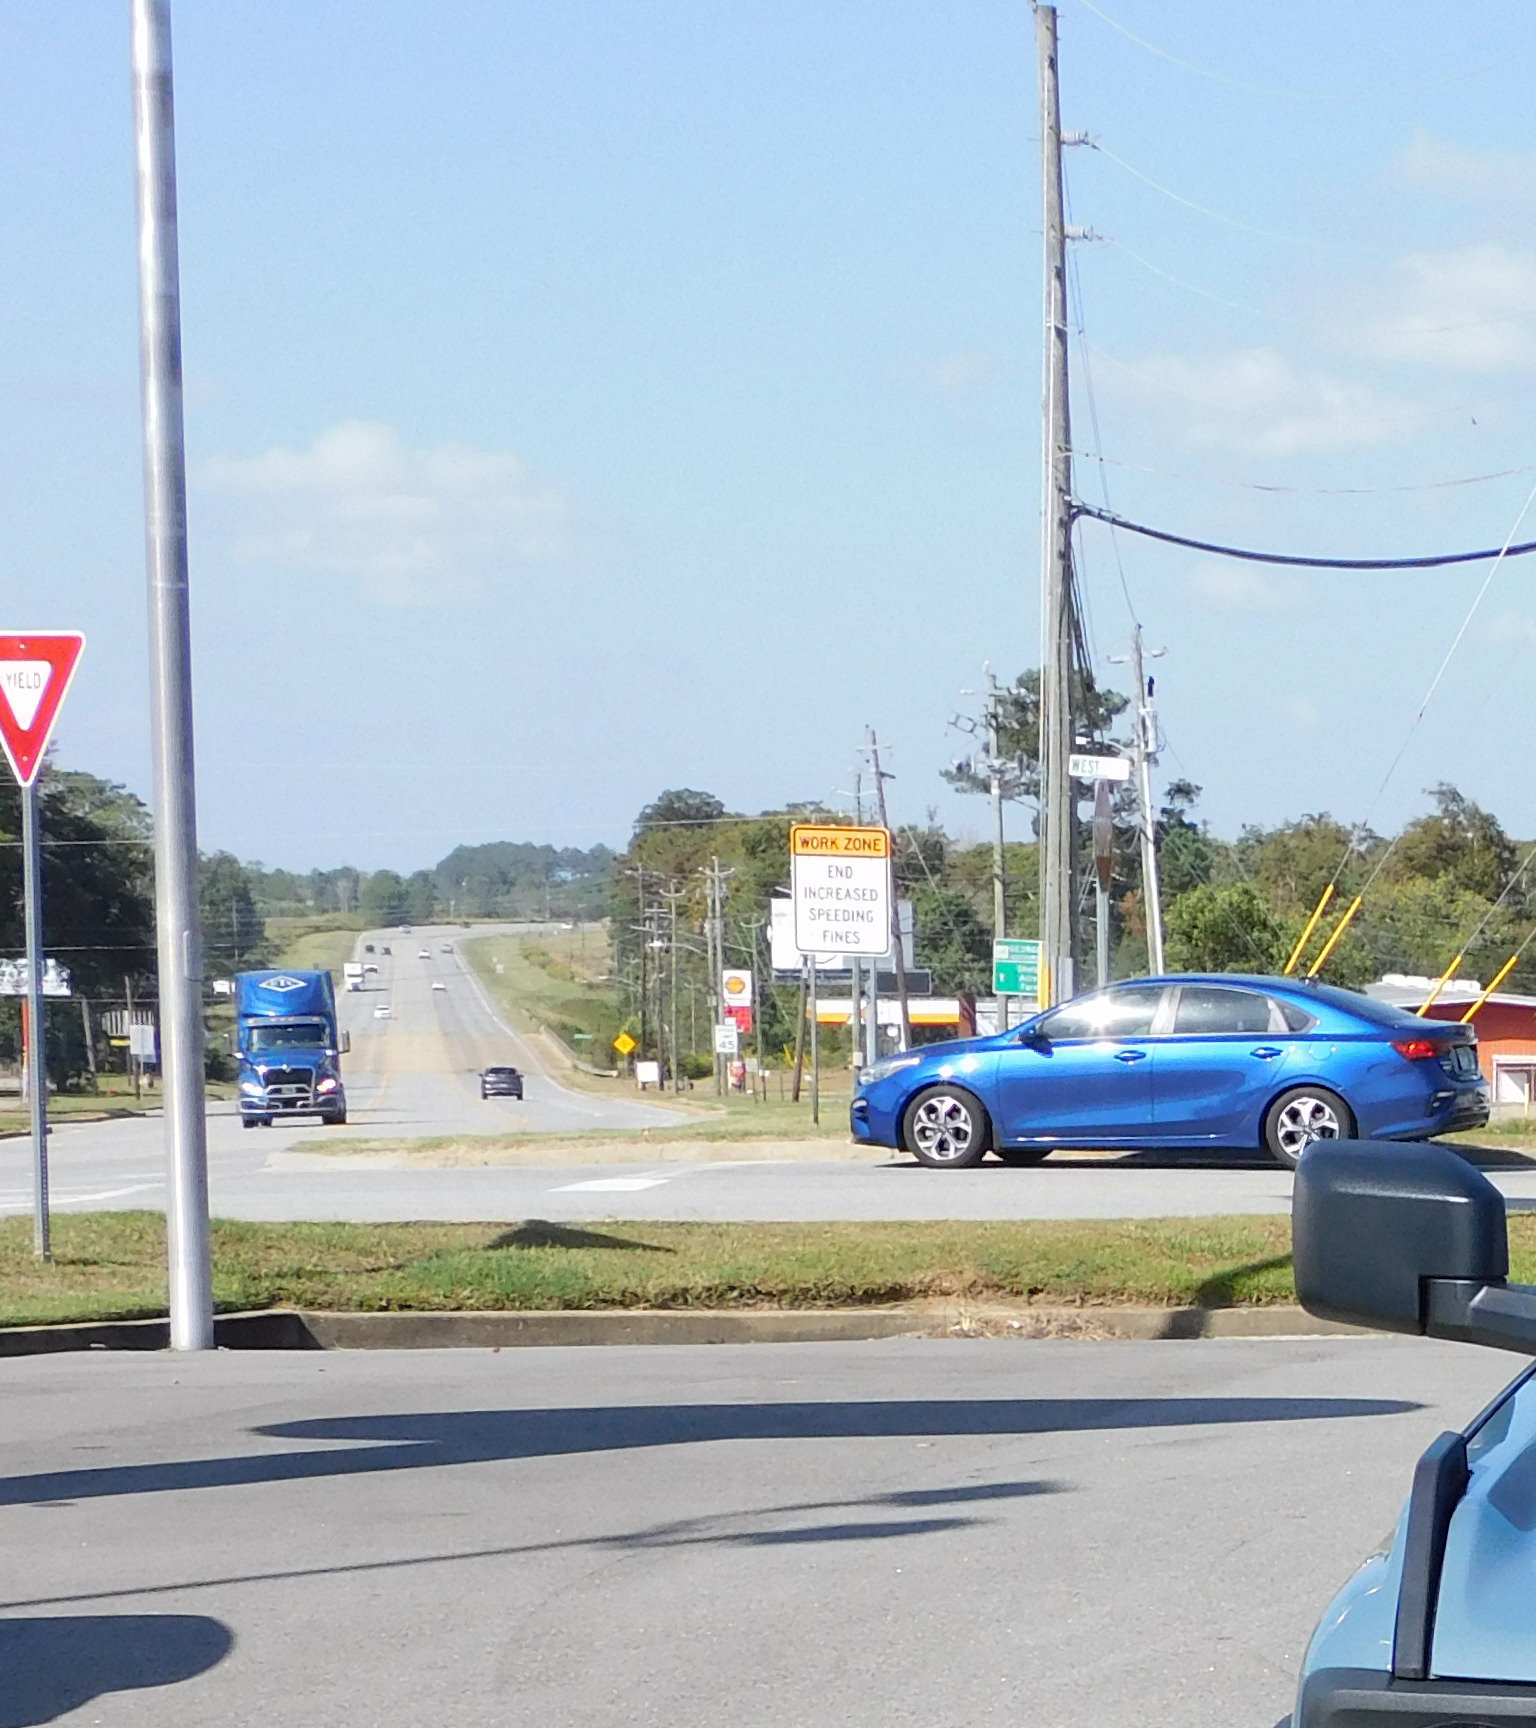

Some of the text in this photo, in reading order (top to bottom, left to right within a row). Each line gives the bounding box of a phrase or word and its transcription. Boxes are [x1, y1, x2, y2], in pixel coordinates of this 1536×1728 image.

[6, 672, 41, 689] YIELD
[1072, 758, 1100, 774] WEST
[800, 836, 882, 852] WORK ZONE
[828, 865, 853, 879] END
[804, 886, 878, 901] INCREASED
[809, 908, 874, 923] SPEEDING
[823, 930, 861, 944] FINES
